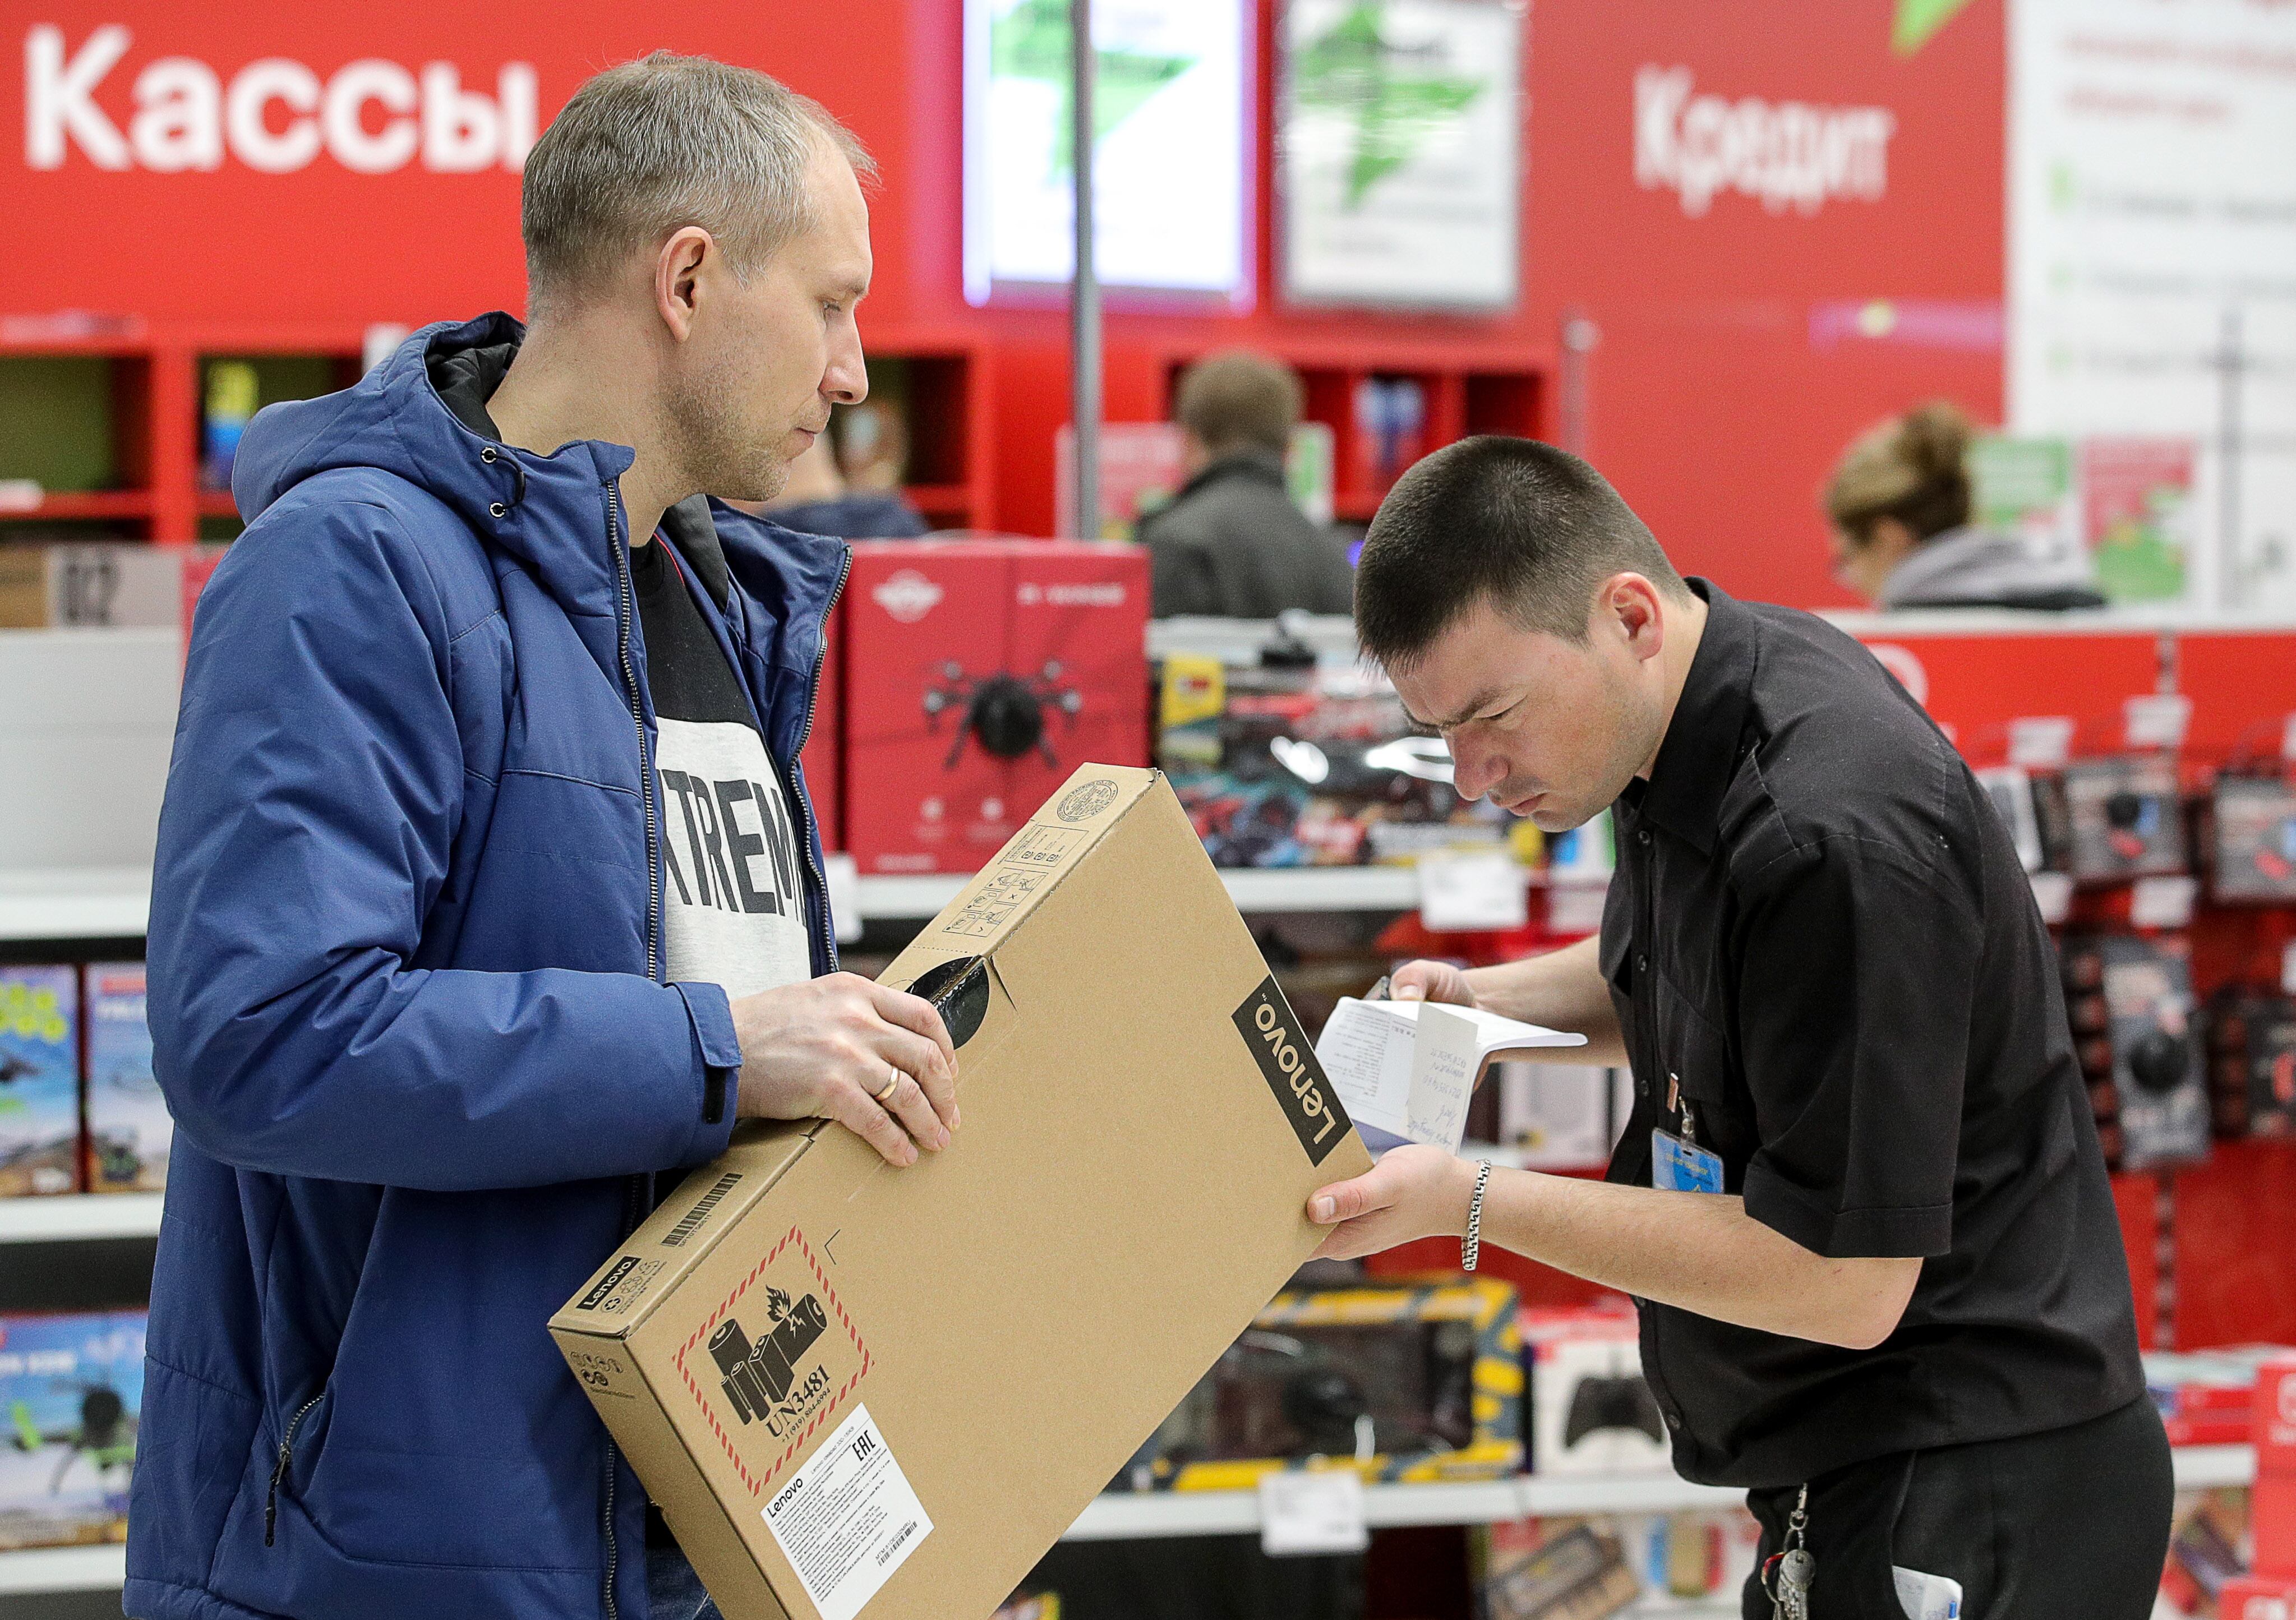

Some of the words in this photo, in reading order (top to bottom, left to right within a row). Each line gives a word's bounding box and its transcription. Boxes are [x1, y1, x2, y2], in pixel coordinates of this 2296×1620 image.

[25, 23, 538, 173] Кассы
[1631, 63, 1897, 218] Кредит
[1255, 1002, 1337, 1144] Lenovo
[584, 1259, 632, 1307] Lenovo
[766, 1364, 832, 1437] UN3481
[781, 1430, 792, 1443] +1
[790, 1416, 806, 1438] (919)
[806, 1388, 832, 1418] 804-6994
[852, 1429, 877, 1462] EAC
[767, 1476, 804, 1519] Lenovo
